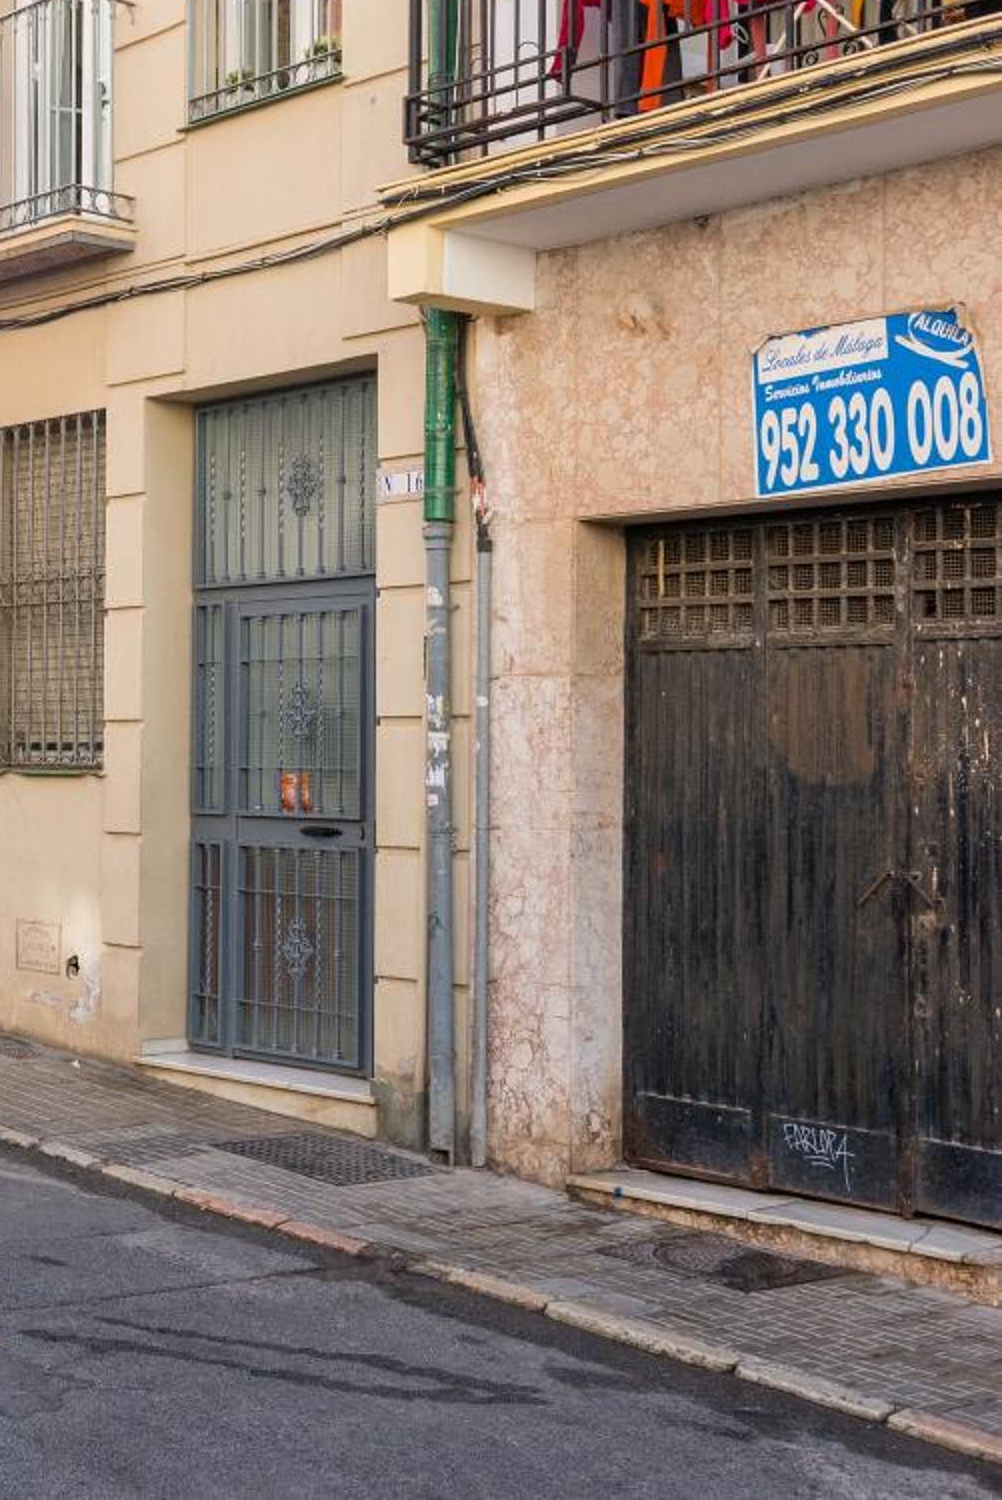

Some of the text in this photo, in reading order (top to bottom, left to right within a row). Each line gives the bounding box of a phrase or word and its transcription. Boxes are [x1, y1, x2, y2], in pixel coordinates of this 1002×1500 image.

[913, 312, 970, 347] ALQUILA
[761, 344, 812, 372] Locales
[813, 340, 830, 360] de
[764, 367, 883, 402] Servicios Inmobiliarios
[760, 371, 984, 490] 952 330 008
